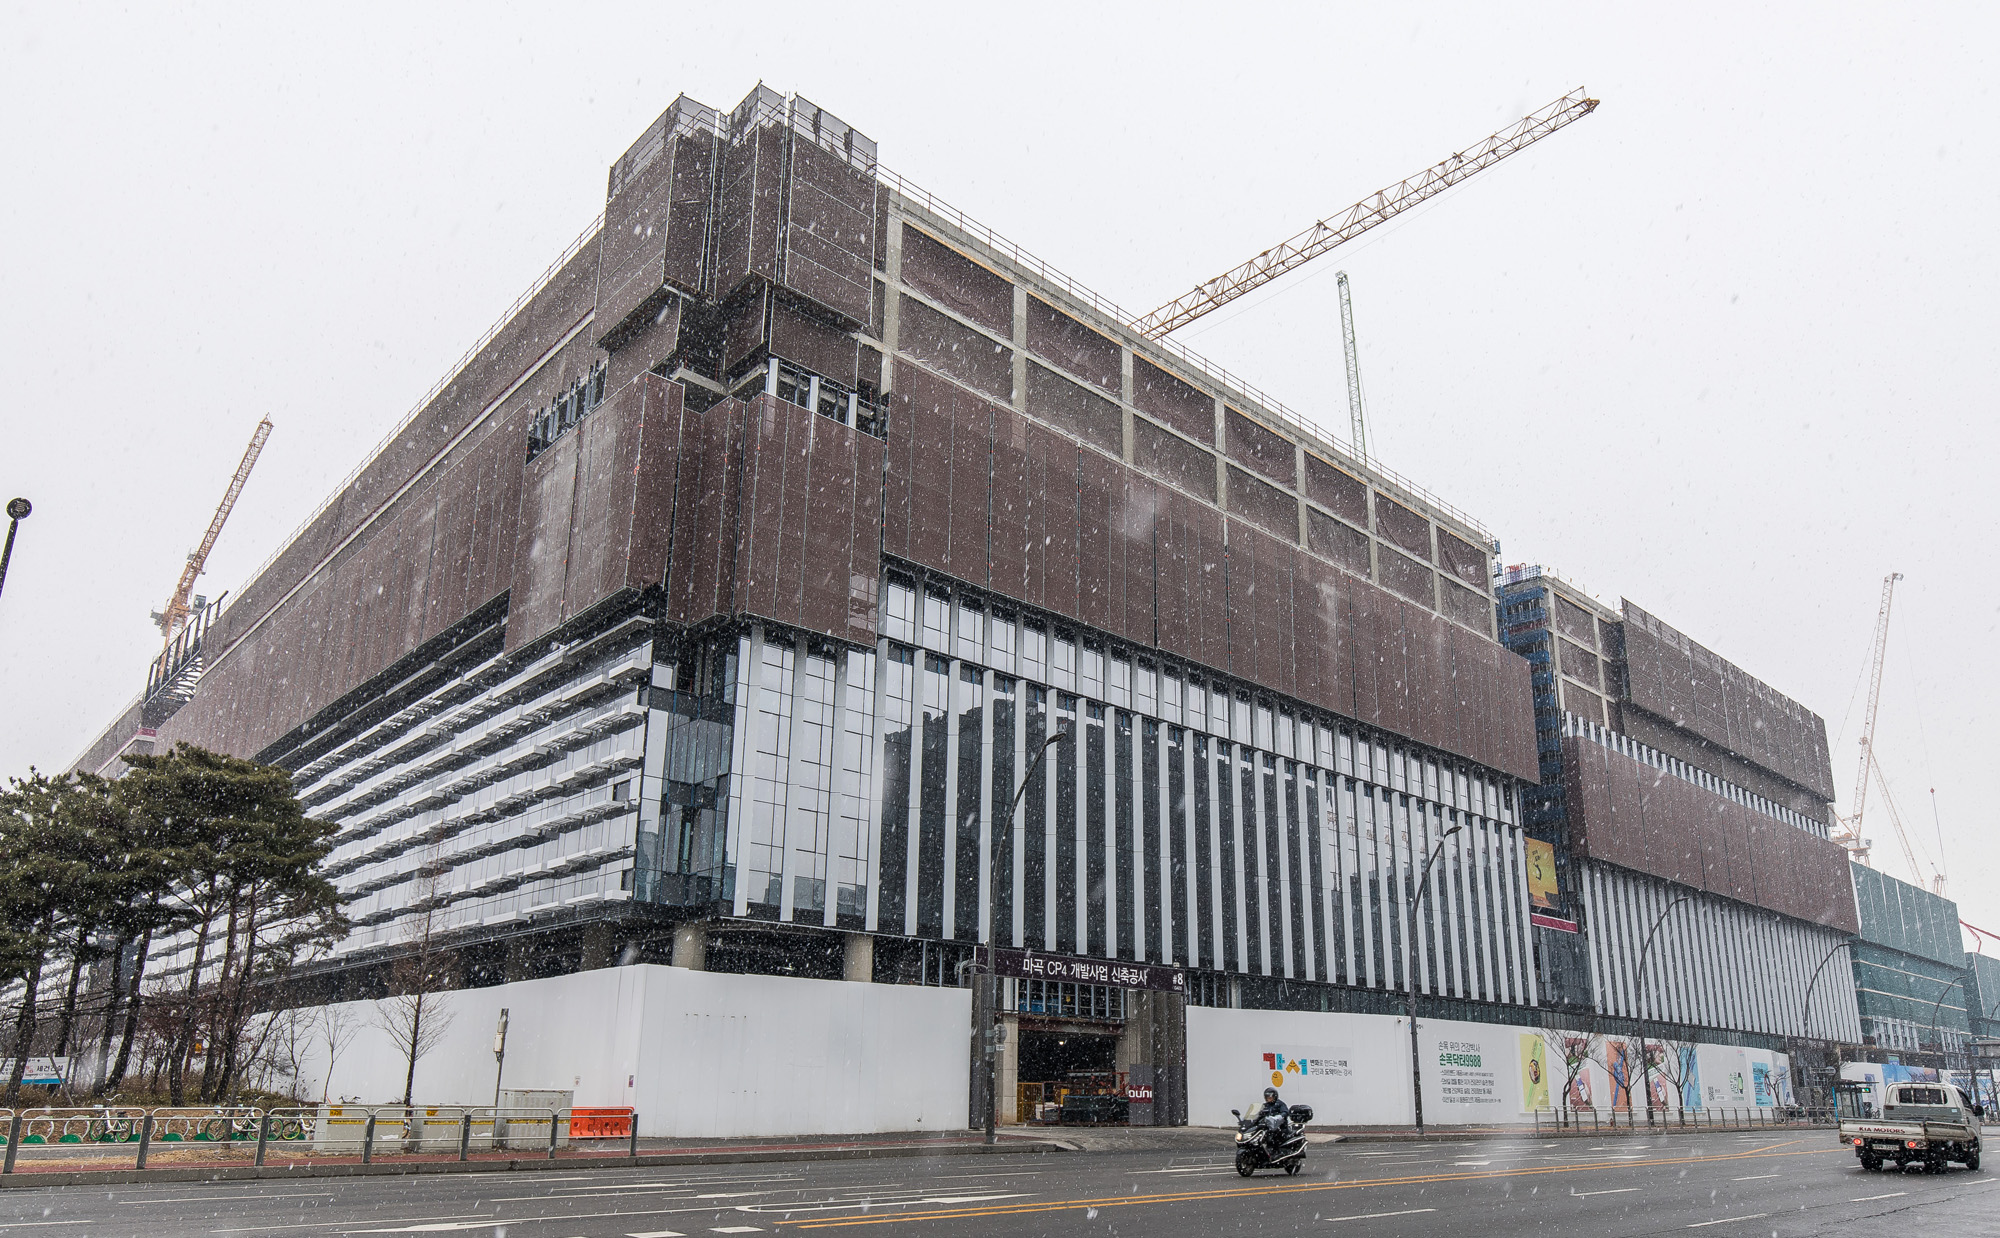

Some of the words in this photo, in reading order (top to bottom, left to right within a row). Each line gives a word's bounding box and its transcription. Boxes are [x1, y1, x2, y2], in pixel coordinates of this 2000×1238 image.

[1023, 958, 1044, 975] 마곡
[1047, 961, 1067, 976] CP4
[1070, 963, 1108, 981] 개발사업
[1111, 968, 1147, 985] 신축공사
[1172, 973, 1183, 985] #8
[1438, 1040, 1448, 1051] 손목
[1449, 1041, 1459, 1052] 위의
[1439, 1052, 1482, 1068] 손목닥터9988
